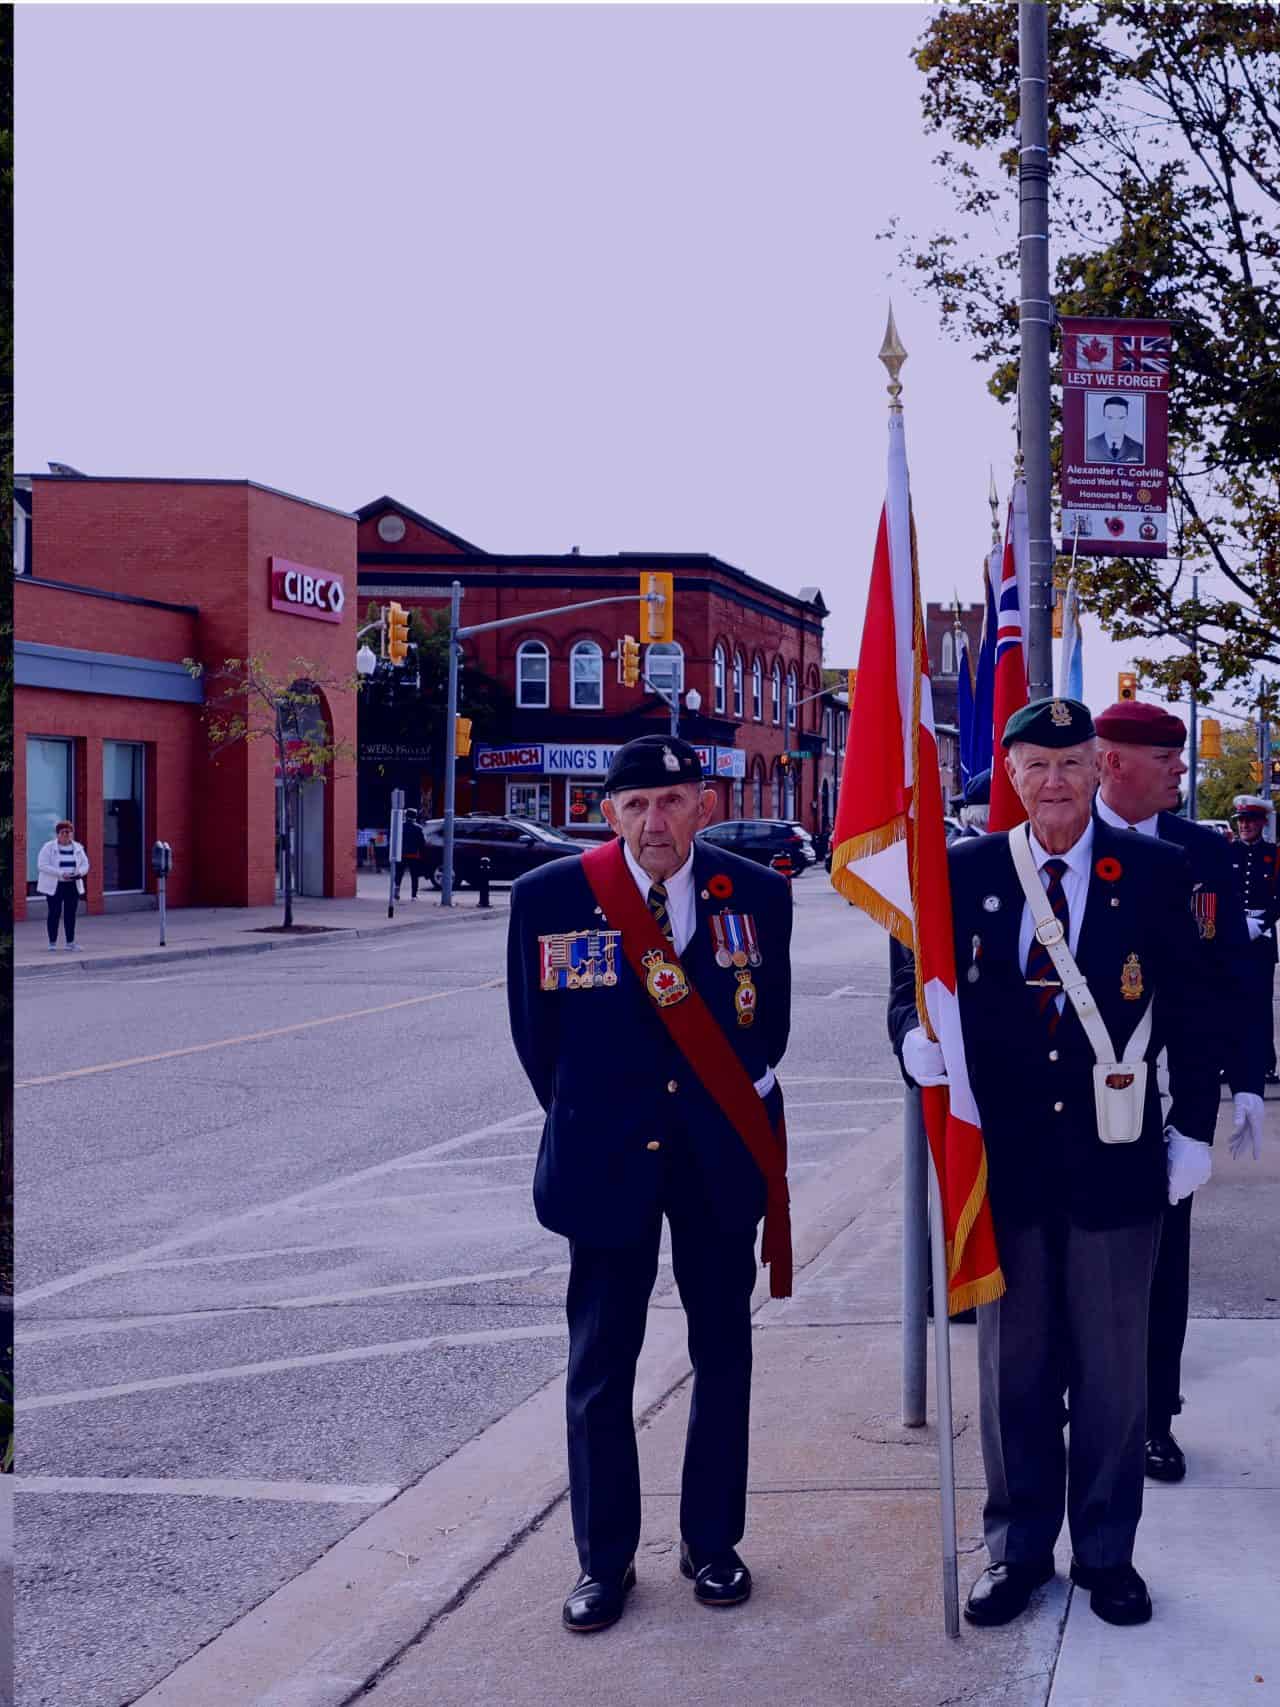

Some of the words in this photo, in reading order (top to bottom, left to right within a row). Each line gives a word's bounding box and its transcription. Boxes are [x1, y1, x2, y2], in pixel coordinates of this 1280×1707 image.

[1068, 373, 1093, 384] LEST
[1095, 374, 1115, 385] WE
[1117, 374, 1163, 387] FORGET
[1067, 465, 1114, 475] Alexander
[1117, 467, 1127, 476] C.
[1129, 468, 1165, 477] Colville
[1068, 477, 1096, 485] Second
[1097, 478, 1119, 486] World
[1120, 479, 1134, 487] War
[1140, 480, 1162, 488] RCAF
[1079, 490, 1120, 499] Honoured
[1121, 491, 1133, 501] By
[1067, 501, 1116, 510] Bowmanville
[1117, 502, 1142, 511] Rotary
[1143, 504, 1163, 512] Club
[284, 571, 326, 608] CIBC
[479, 749, 539, 768] CRUNCH
[549, 750, 597, 769] KING'S
